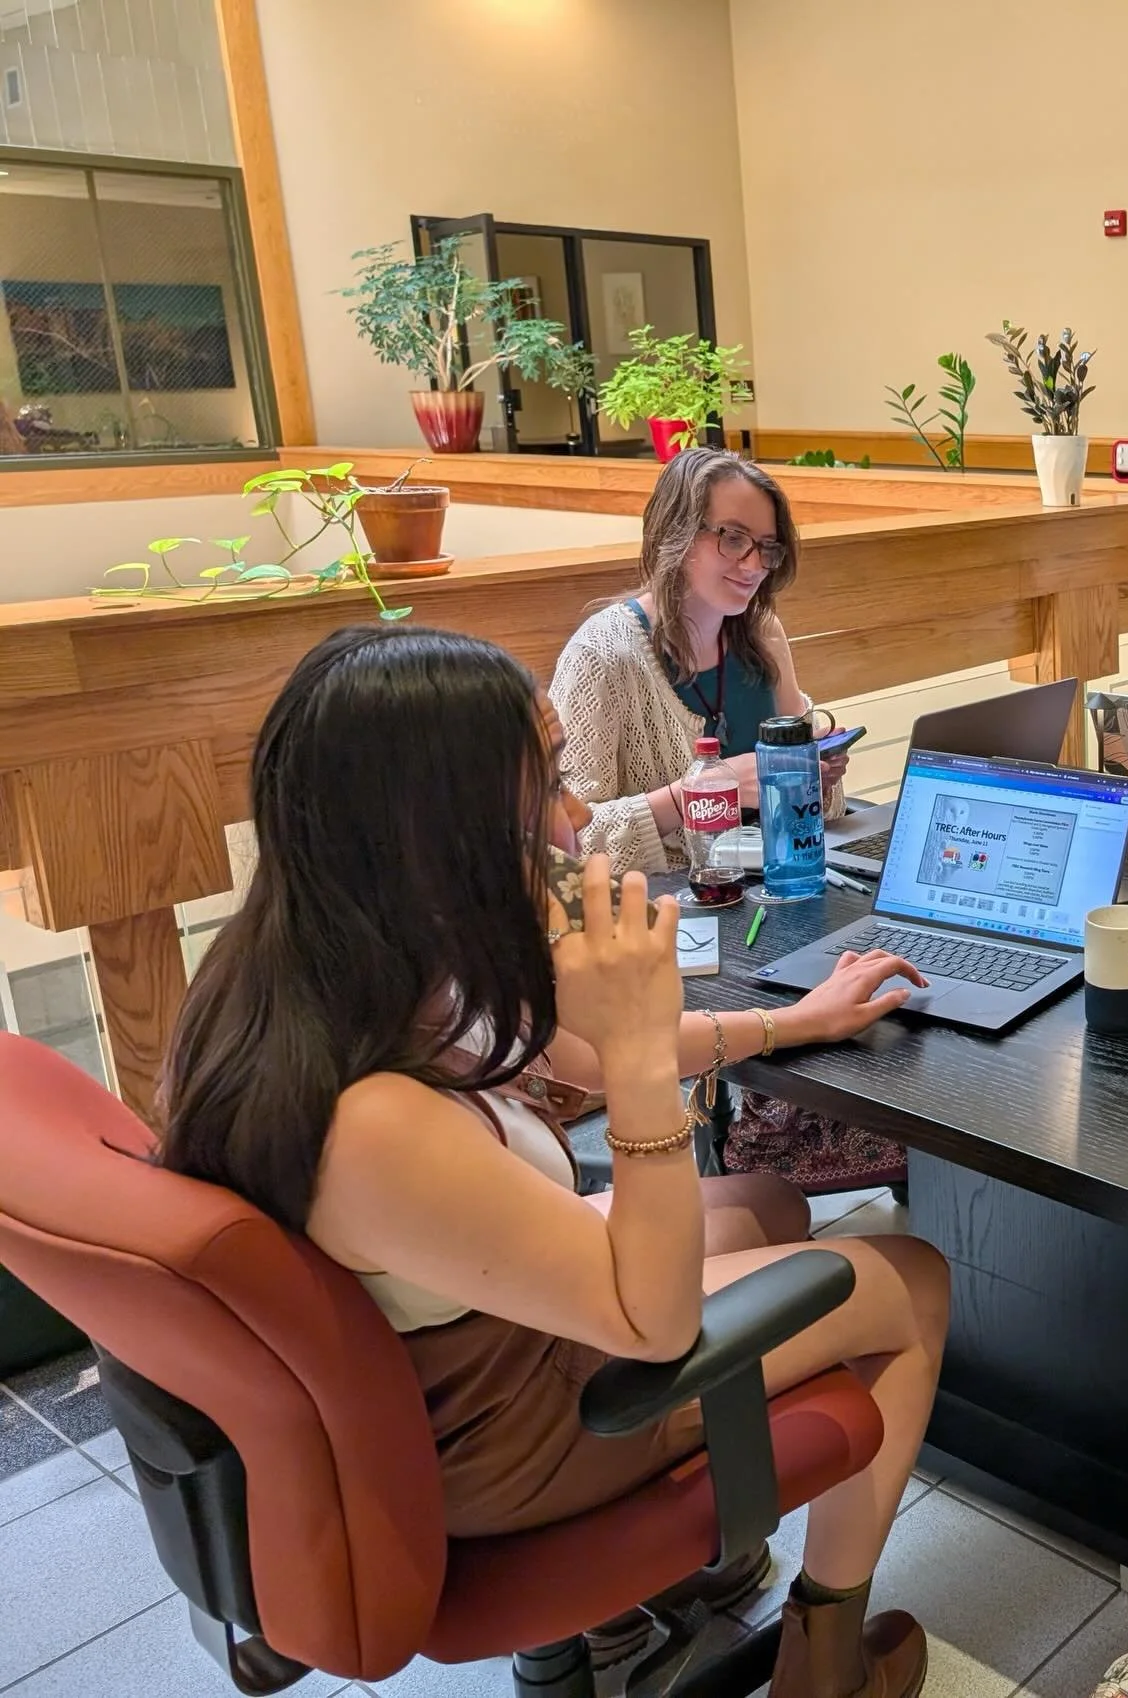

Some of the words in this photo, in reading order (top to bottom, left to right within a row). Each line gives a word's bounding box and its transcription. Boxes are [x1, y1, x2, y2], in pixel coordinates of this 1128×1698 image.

[688, 800, 725, 820] Pepper
[791, 801, 820, 818] YO
[935, 822, 960, 835] TREC:
[959, 827, 982, 838] After
[981, 829, 1007, 842] Hours
